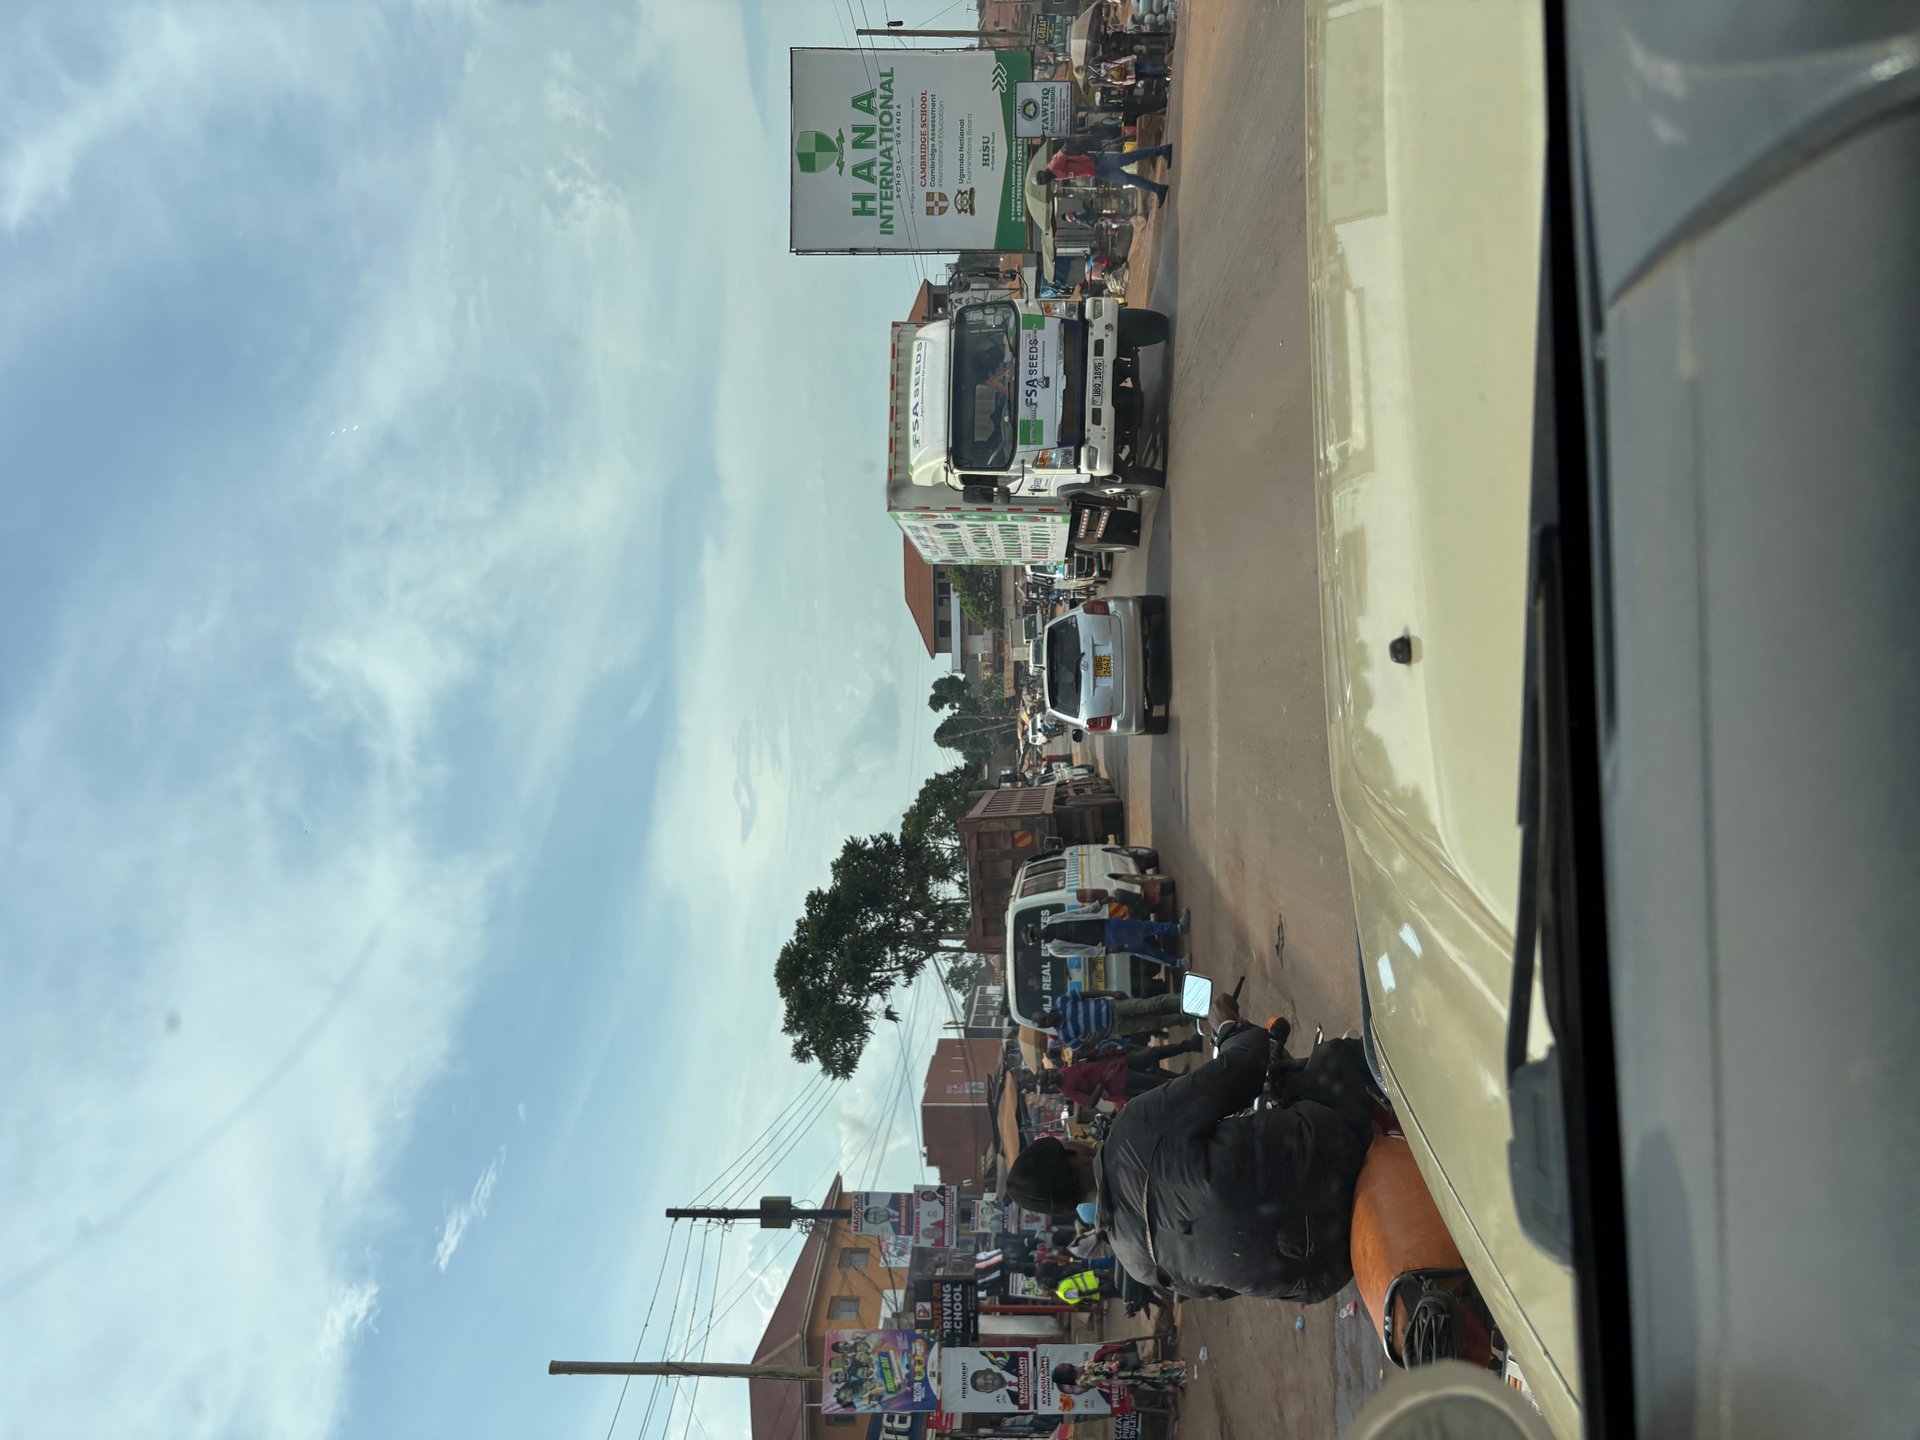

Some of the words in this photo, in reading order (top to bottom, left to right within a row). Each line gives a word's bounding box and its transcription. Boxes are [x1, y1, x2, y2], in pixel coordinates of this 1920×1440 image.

[1041, 87, 1050, 131] TAWFIQ
[851, 88, 877, 216] HANA
[879, 67, 894, 235] INTERNATIONAL
[929, 143, 937, 187] Cambridge
[982, 135, 990, 167] HISU
[913, 341, 923, 398] SEEDS
[1028, 338, 1038, 376] SEEDS
[1025, 378, 1038, 407] FSA
[912, 401, 920, 448] FSA
[1040, 909, 1050, 957] ESTES
[1042, 961, 1051, 991] REAL
